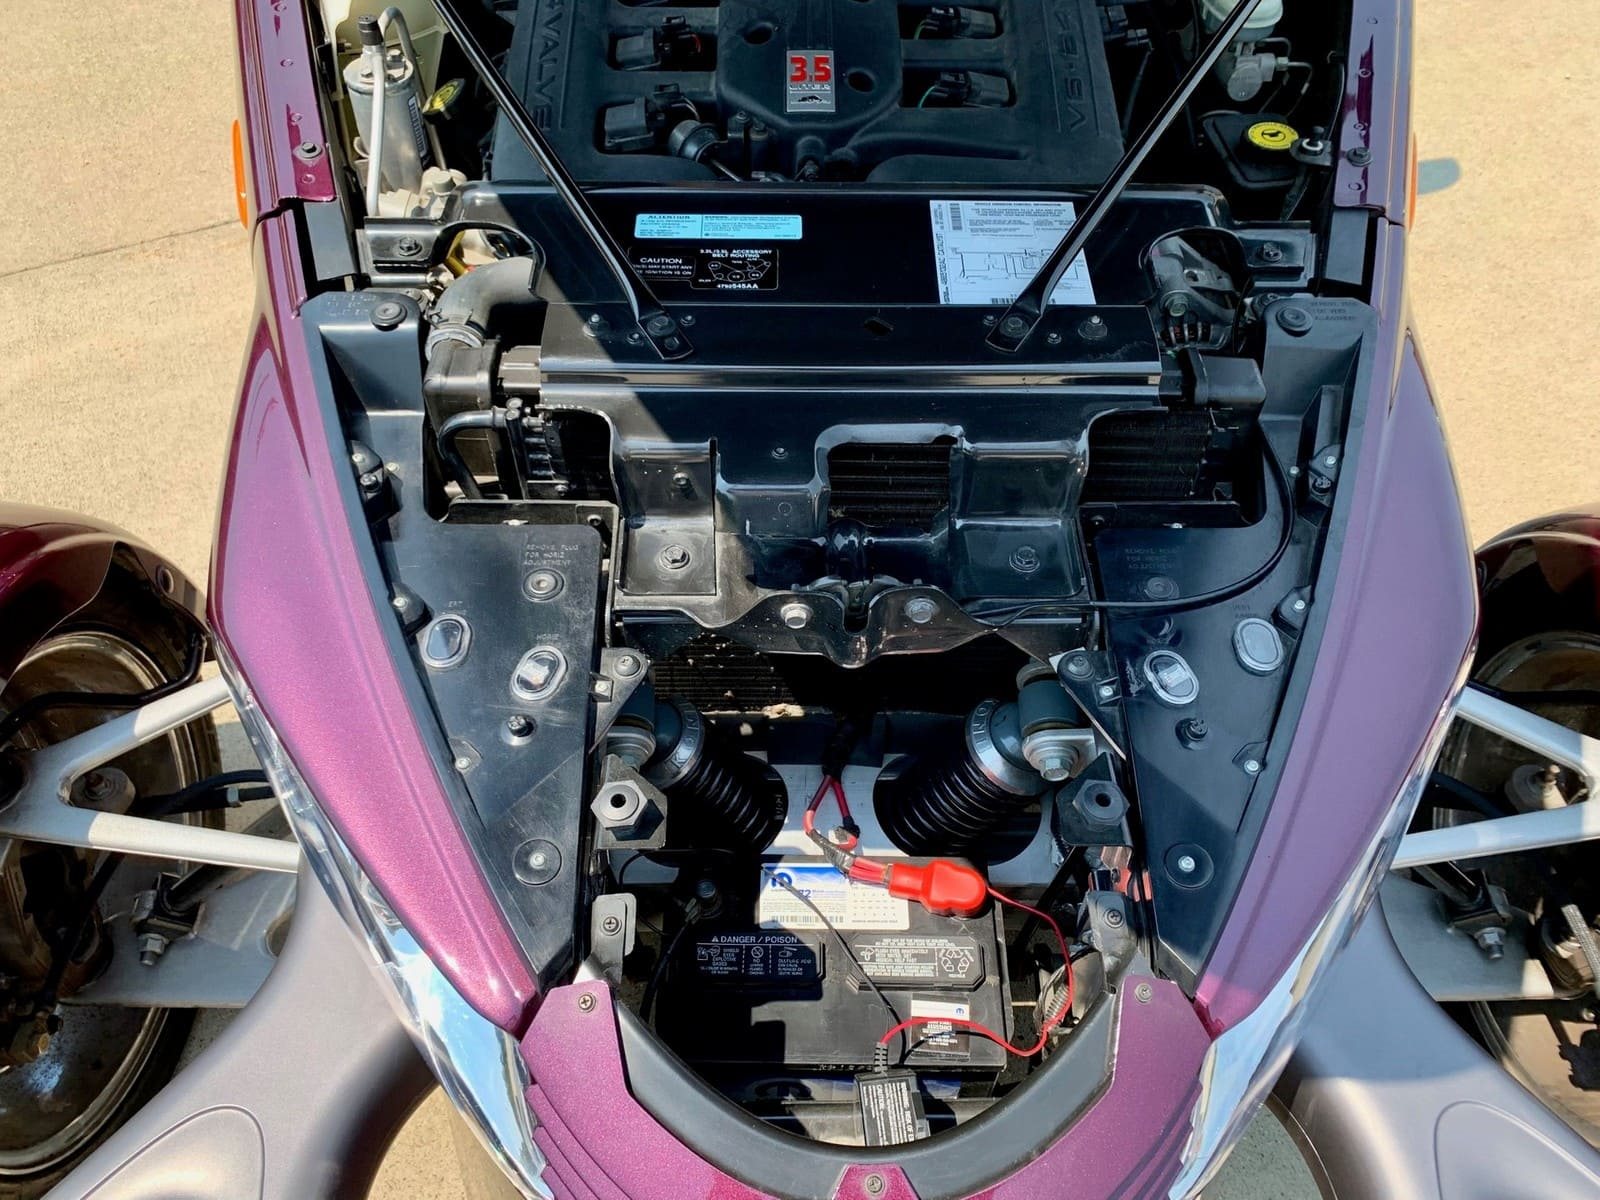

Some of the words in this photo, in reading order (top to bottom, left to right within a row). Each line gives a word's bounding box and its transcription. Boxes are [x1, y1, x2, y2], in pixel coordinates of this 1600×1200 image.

[534, 13, 563, 129] VALVE
[790, 55, 832, 83] 3.5
[720, 936, 756, 944] DANGER
[765, 936, 798, 944] POISON
